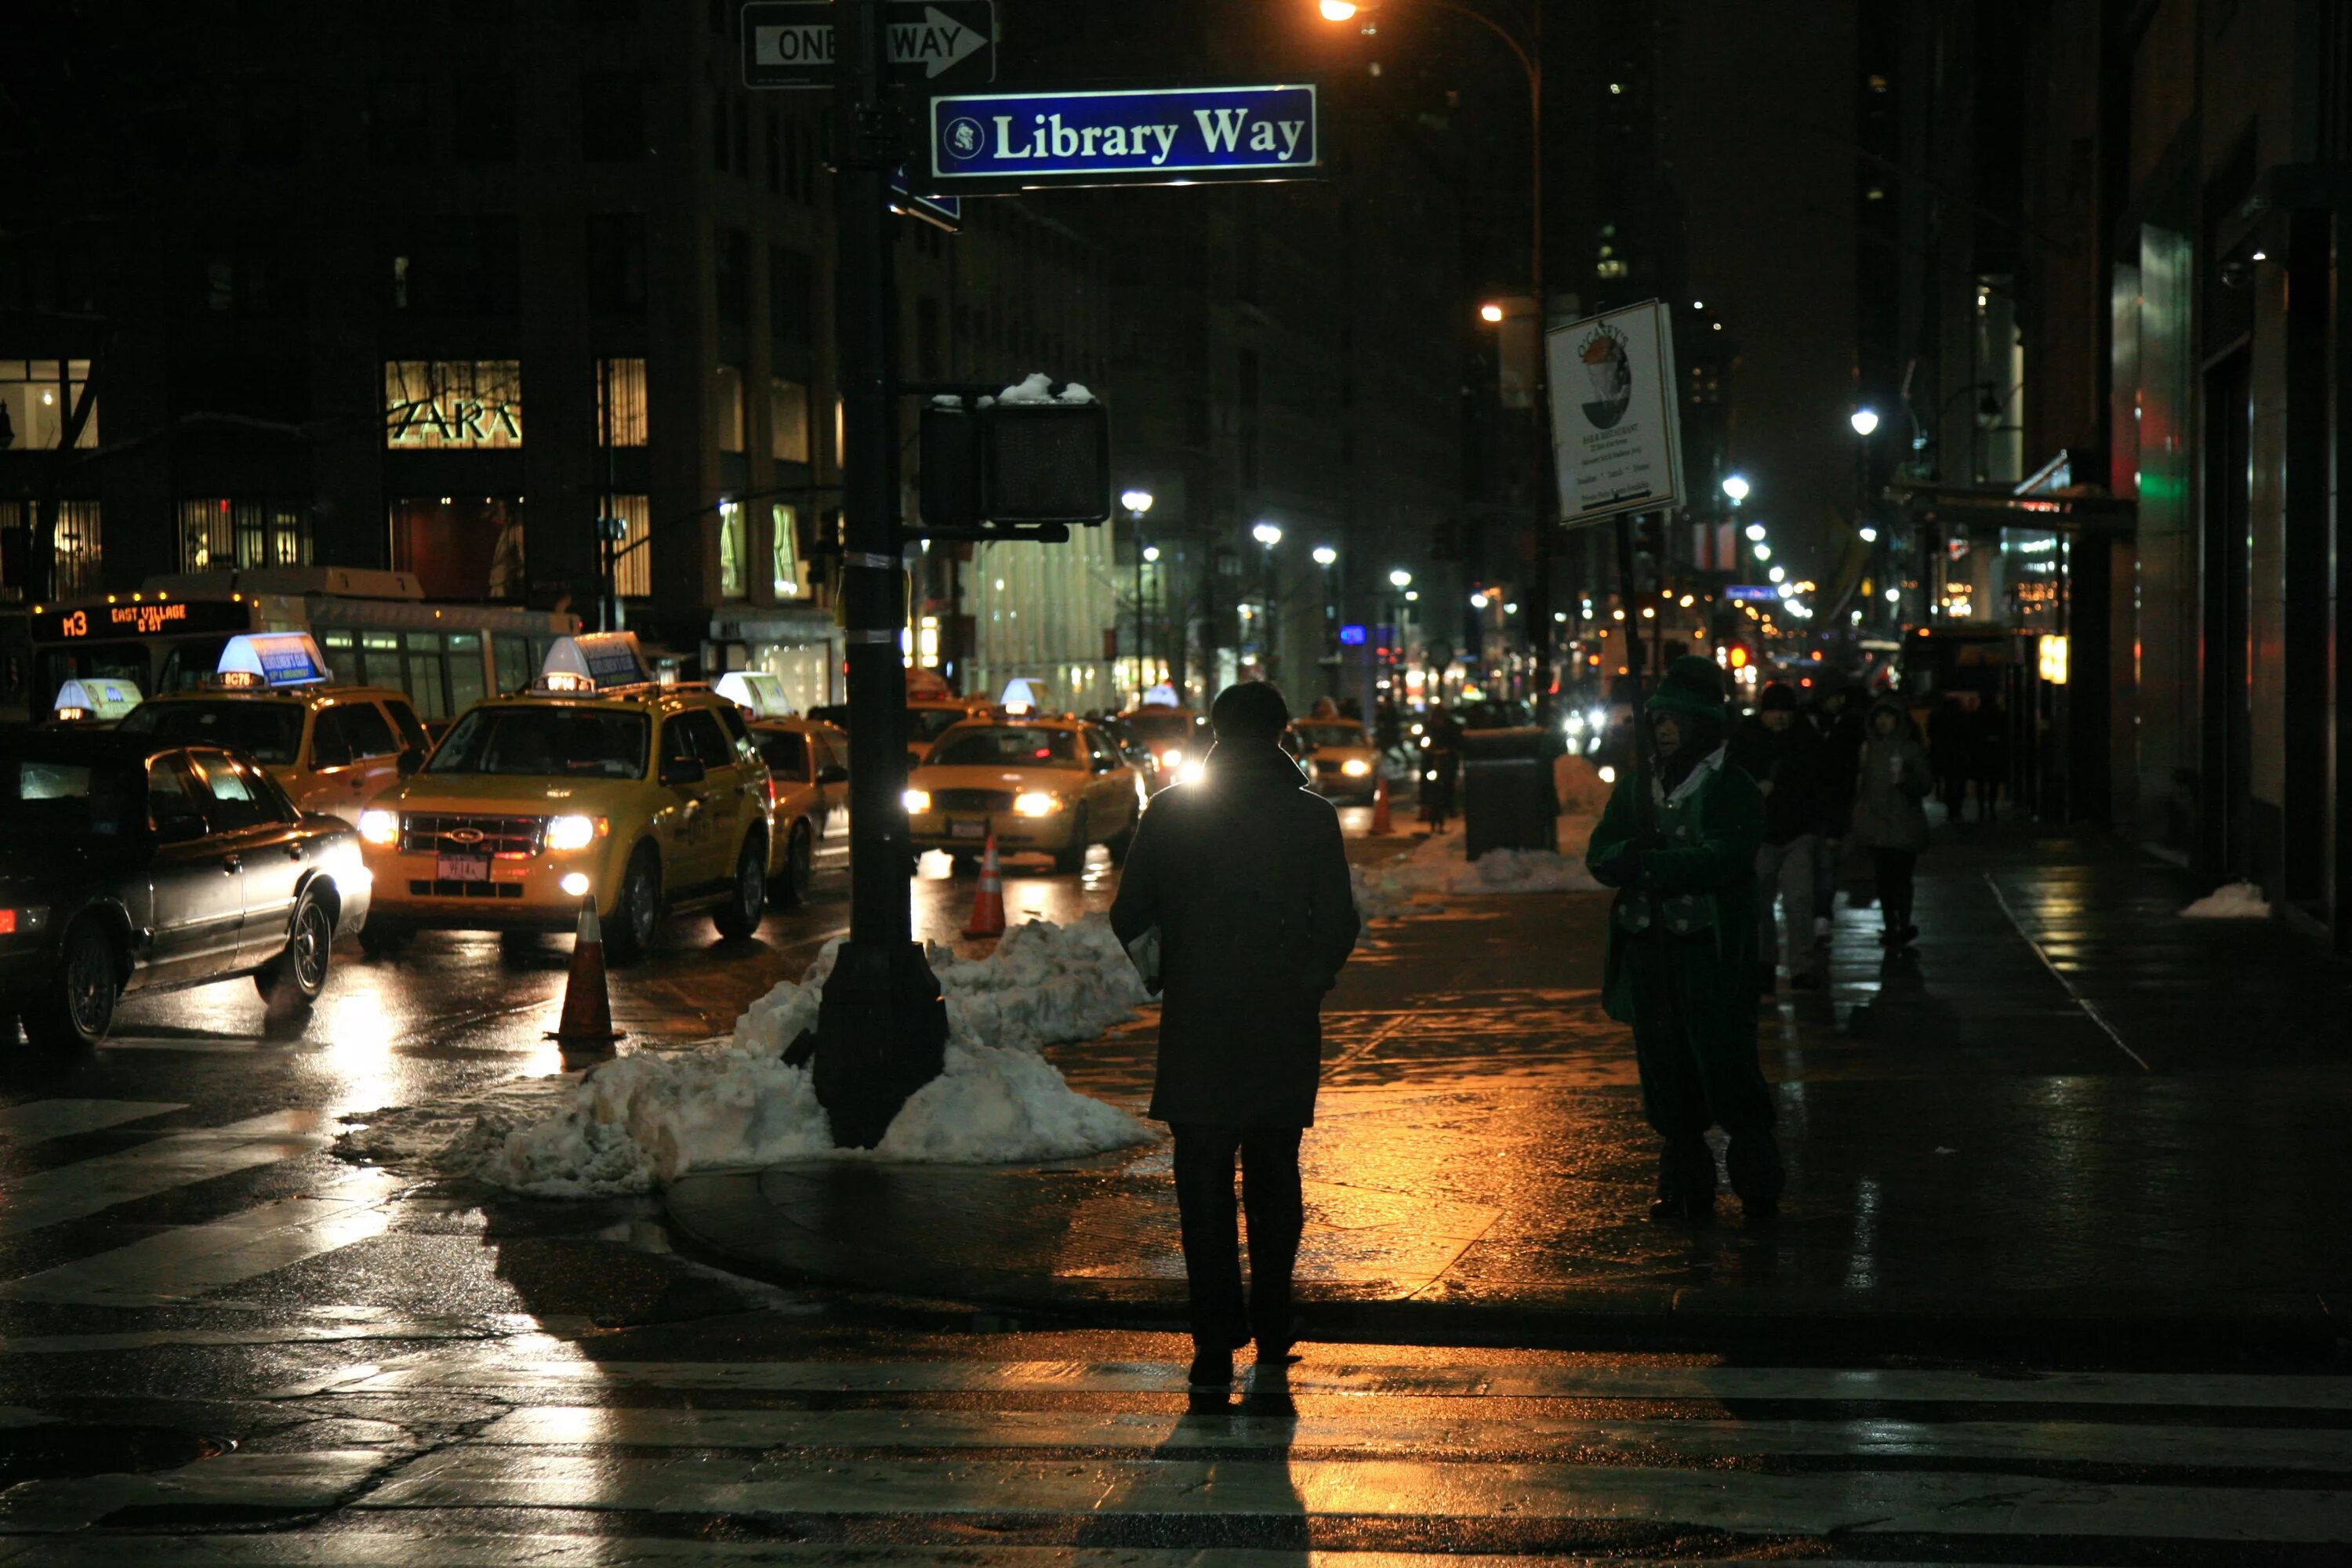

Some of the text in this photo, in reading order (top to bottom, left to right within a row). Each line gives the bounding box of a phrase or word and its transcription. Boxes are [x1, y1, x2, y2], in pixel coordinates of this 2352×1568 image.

[893, 26, 962, 58] WAY
[992, 108, 1305, 165] Library Way
[389, 399, 522, 442] ZARA
[63, 604, 186, 637] M3 EAST VILLAGE
